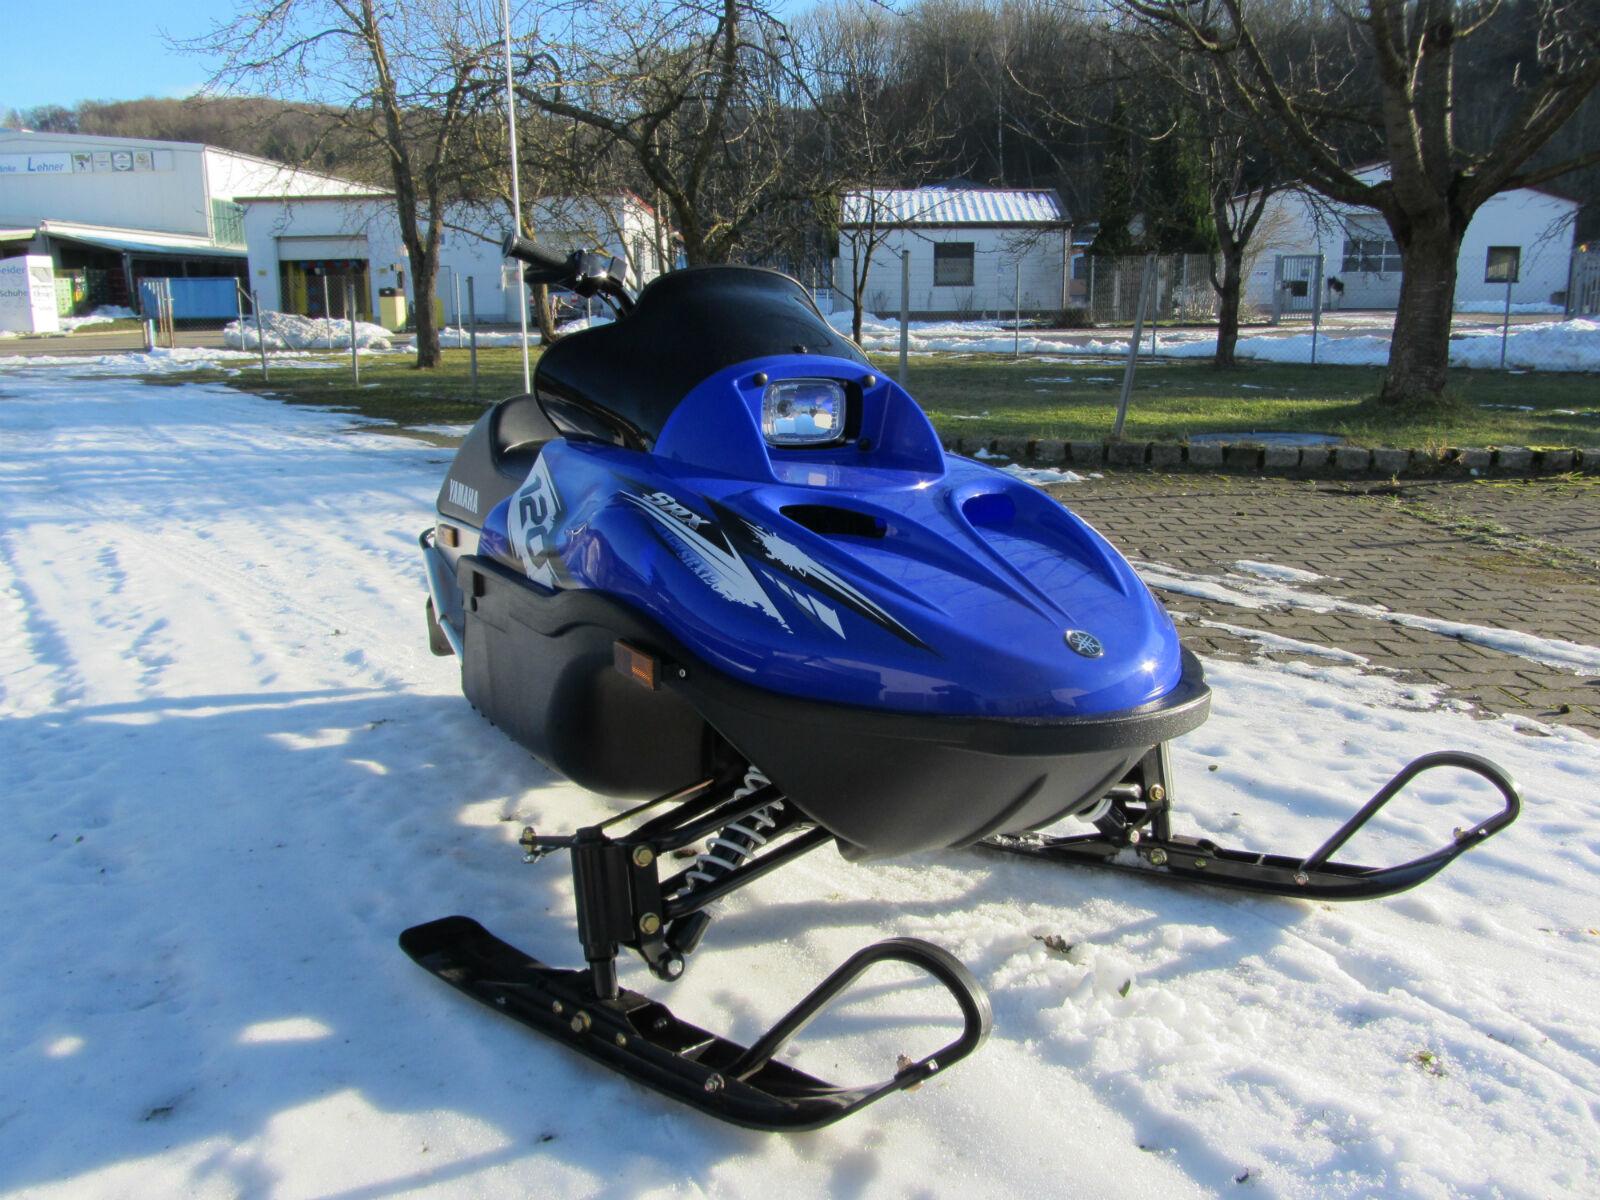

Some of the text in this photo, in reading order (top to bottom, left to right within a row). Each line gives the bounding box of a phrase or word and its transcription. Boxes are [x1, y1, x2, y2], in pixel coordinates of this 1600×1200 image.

[28, 156, 64, 171] Lehner
[449, 479, 479, 514] YAMAHA
[642, 492, 711, 530] SRX
